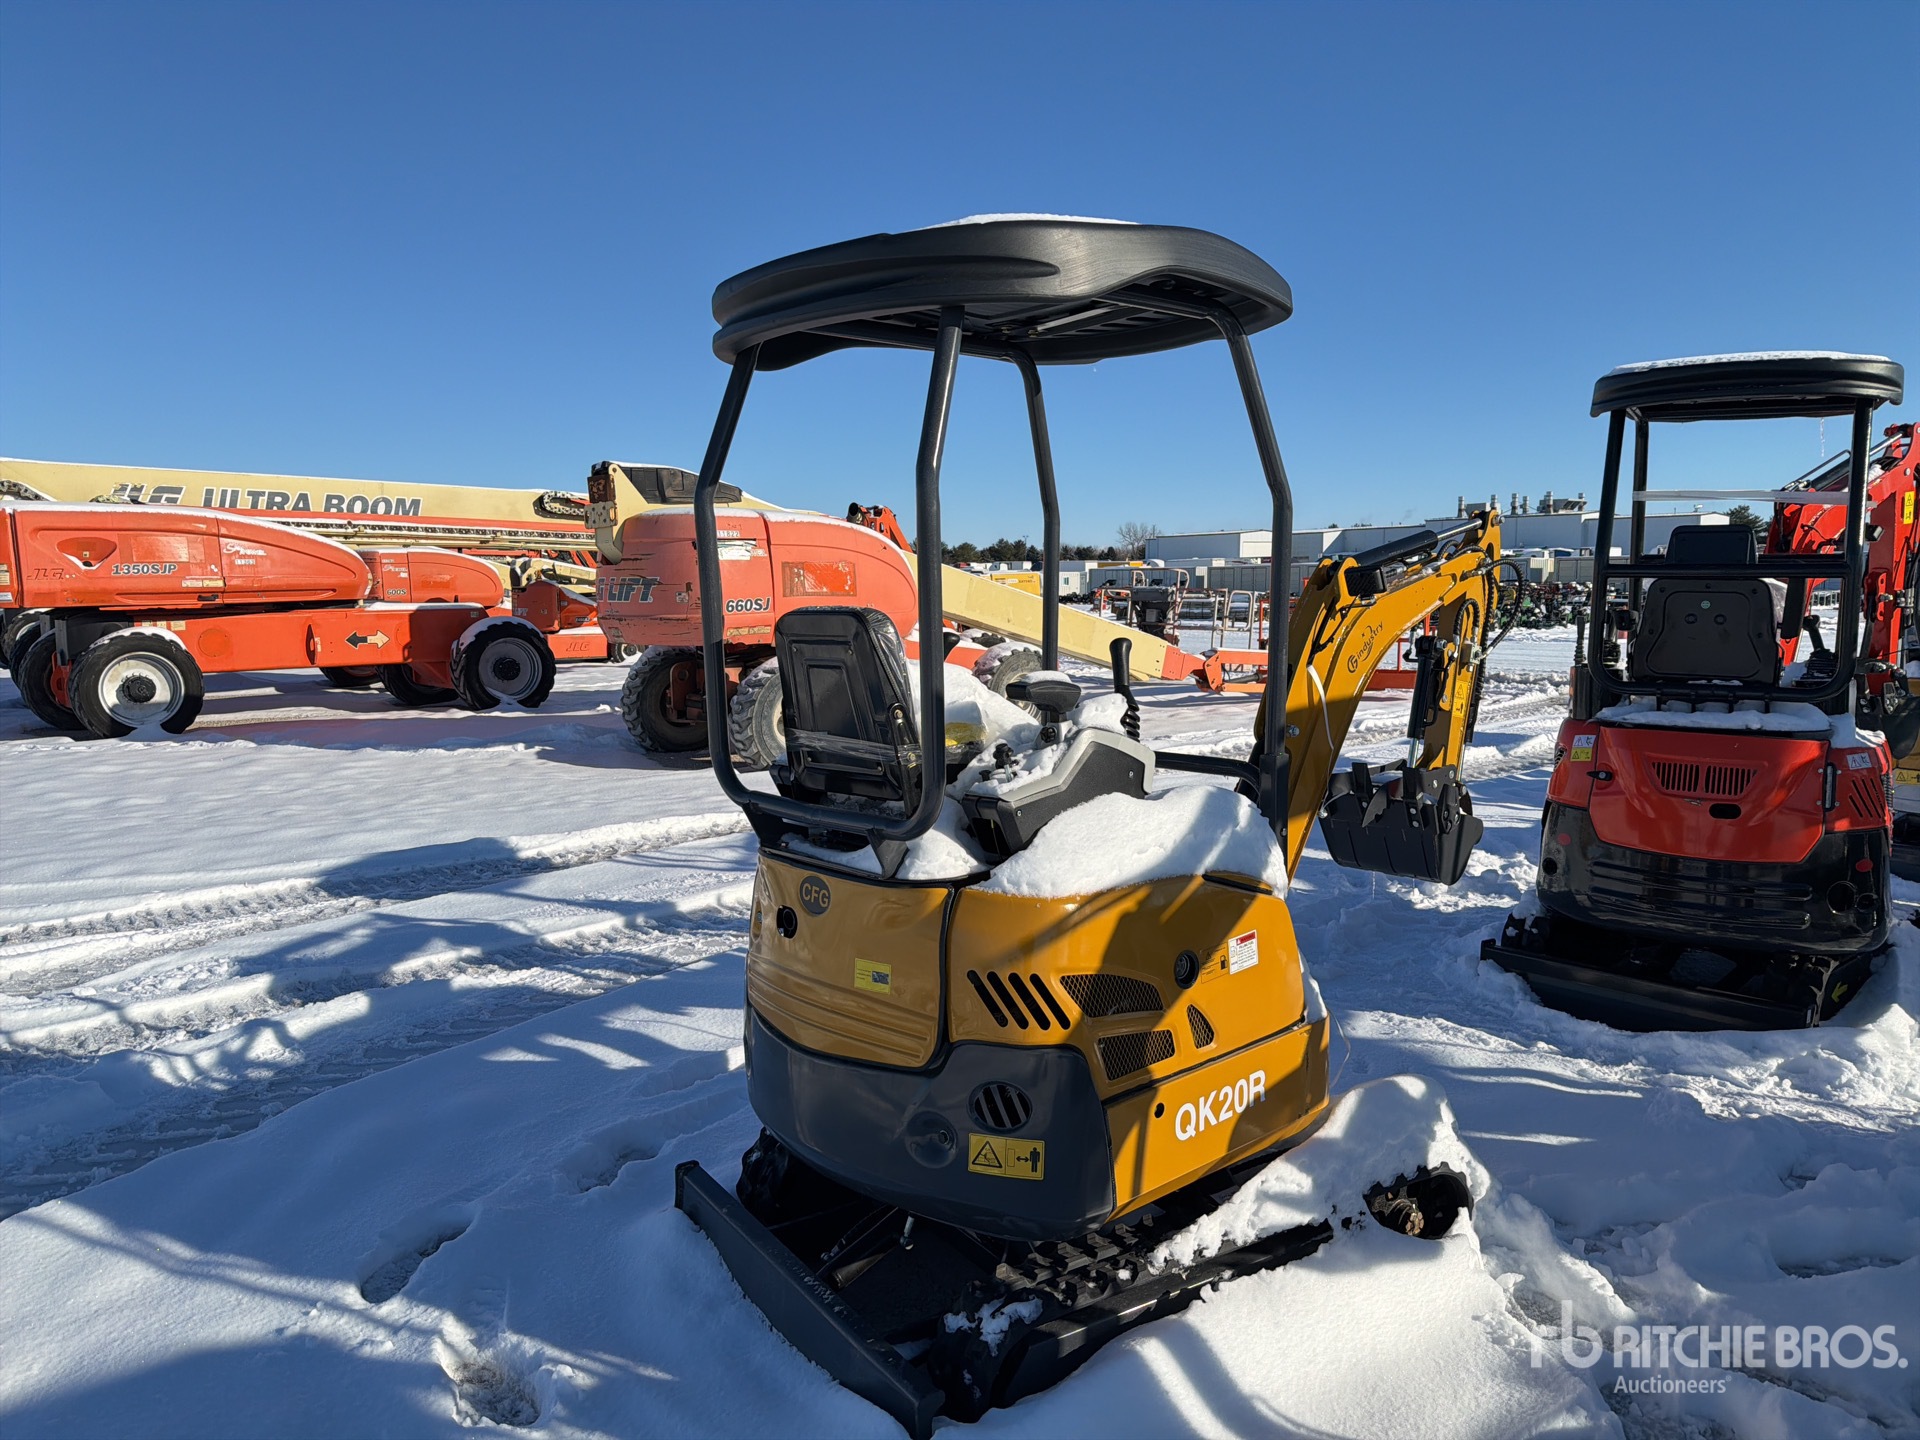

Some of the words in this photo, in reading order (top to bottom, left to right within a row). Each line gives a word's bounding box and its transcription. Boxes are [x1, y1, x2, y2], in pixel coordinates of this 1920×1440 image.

[202, 487, 313, 512] ULTRA
[323, 493, 423, 517] BOOM
[112, 563, 178, 576] 1350SJP
[606, 576, 660, 603] LIFT
[725, 596, 771, 613] 660SJ
[565, 641, 591, 652] JLG
[802, 882, 829, 908] CFG
[1175, 1069, 1267, 1142] QK20R
